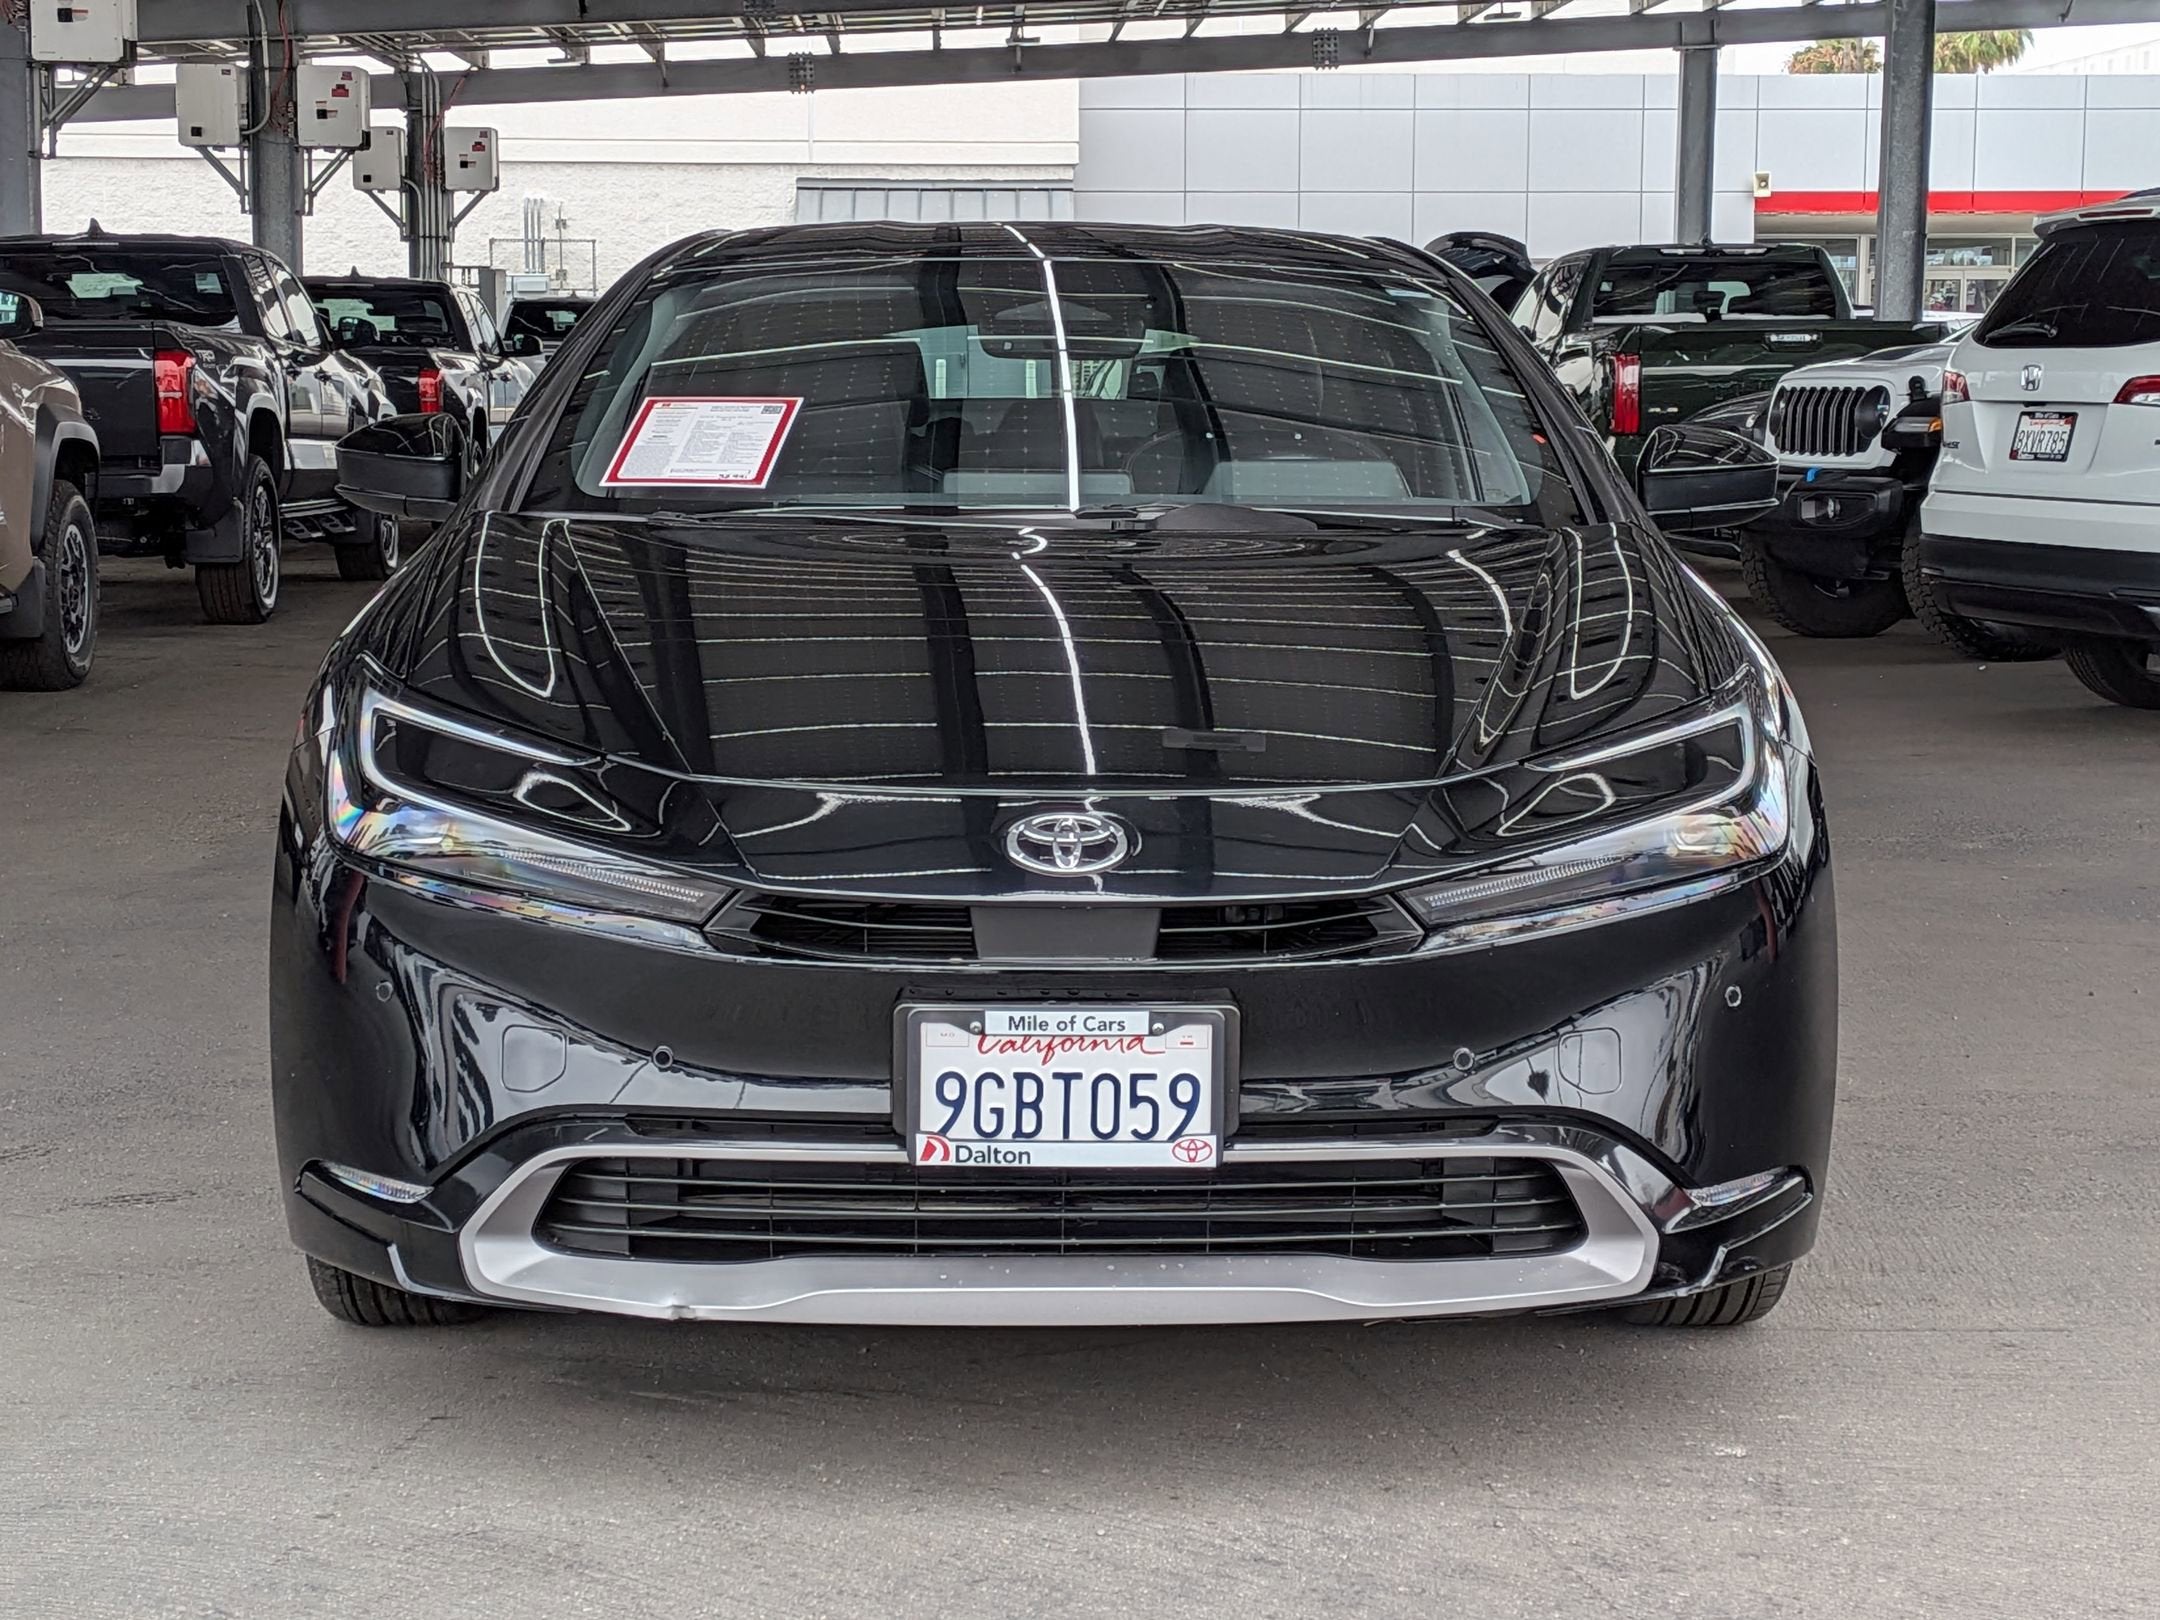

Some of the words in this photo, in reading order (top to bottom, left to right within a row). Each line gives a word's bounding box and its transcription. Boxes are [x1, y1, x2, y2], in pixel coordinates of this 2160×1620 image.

[1008, 1016, 1049, 1031] Mile
[1056, 1016, 1076, 1031] of
[1083, 1017, 1125, 1031] Cars
[977, 1033, 1165, 1065] California
[936, 1071, 1201, 1140] 9GBT059
[955, 1145, 1031, 1164] Dalton
